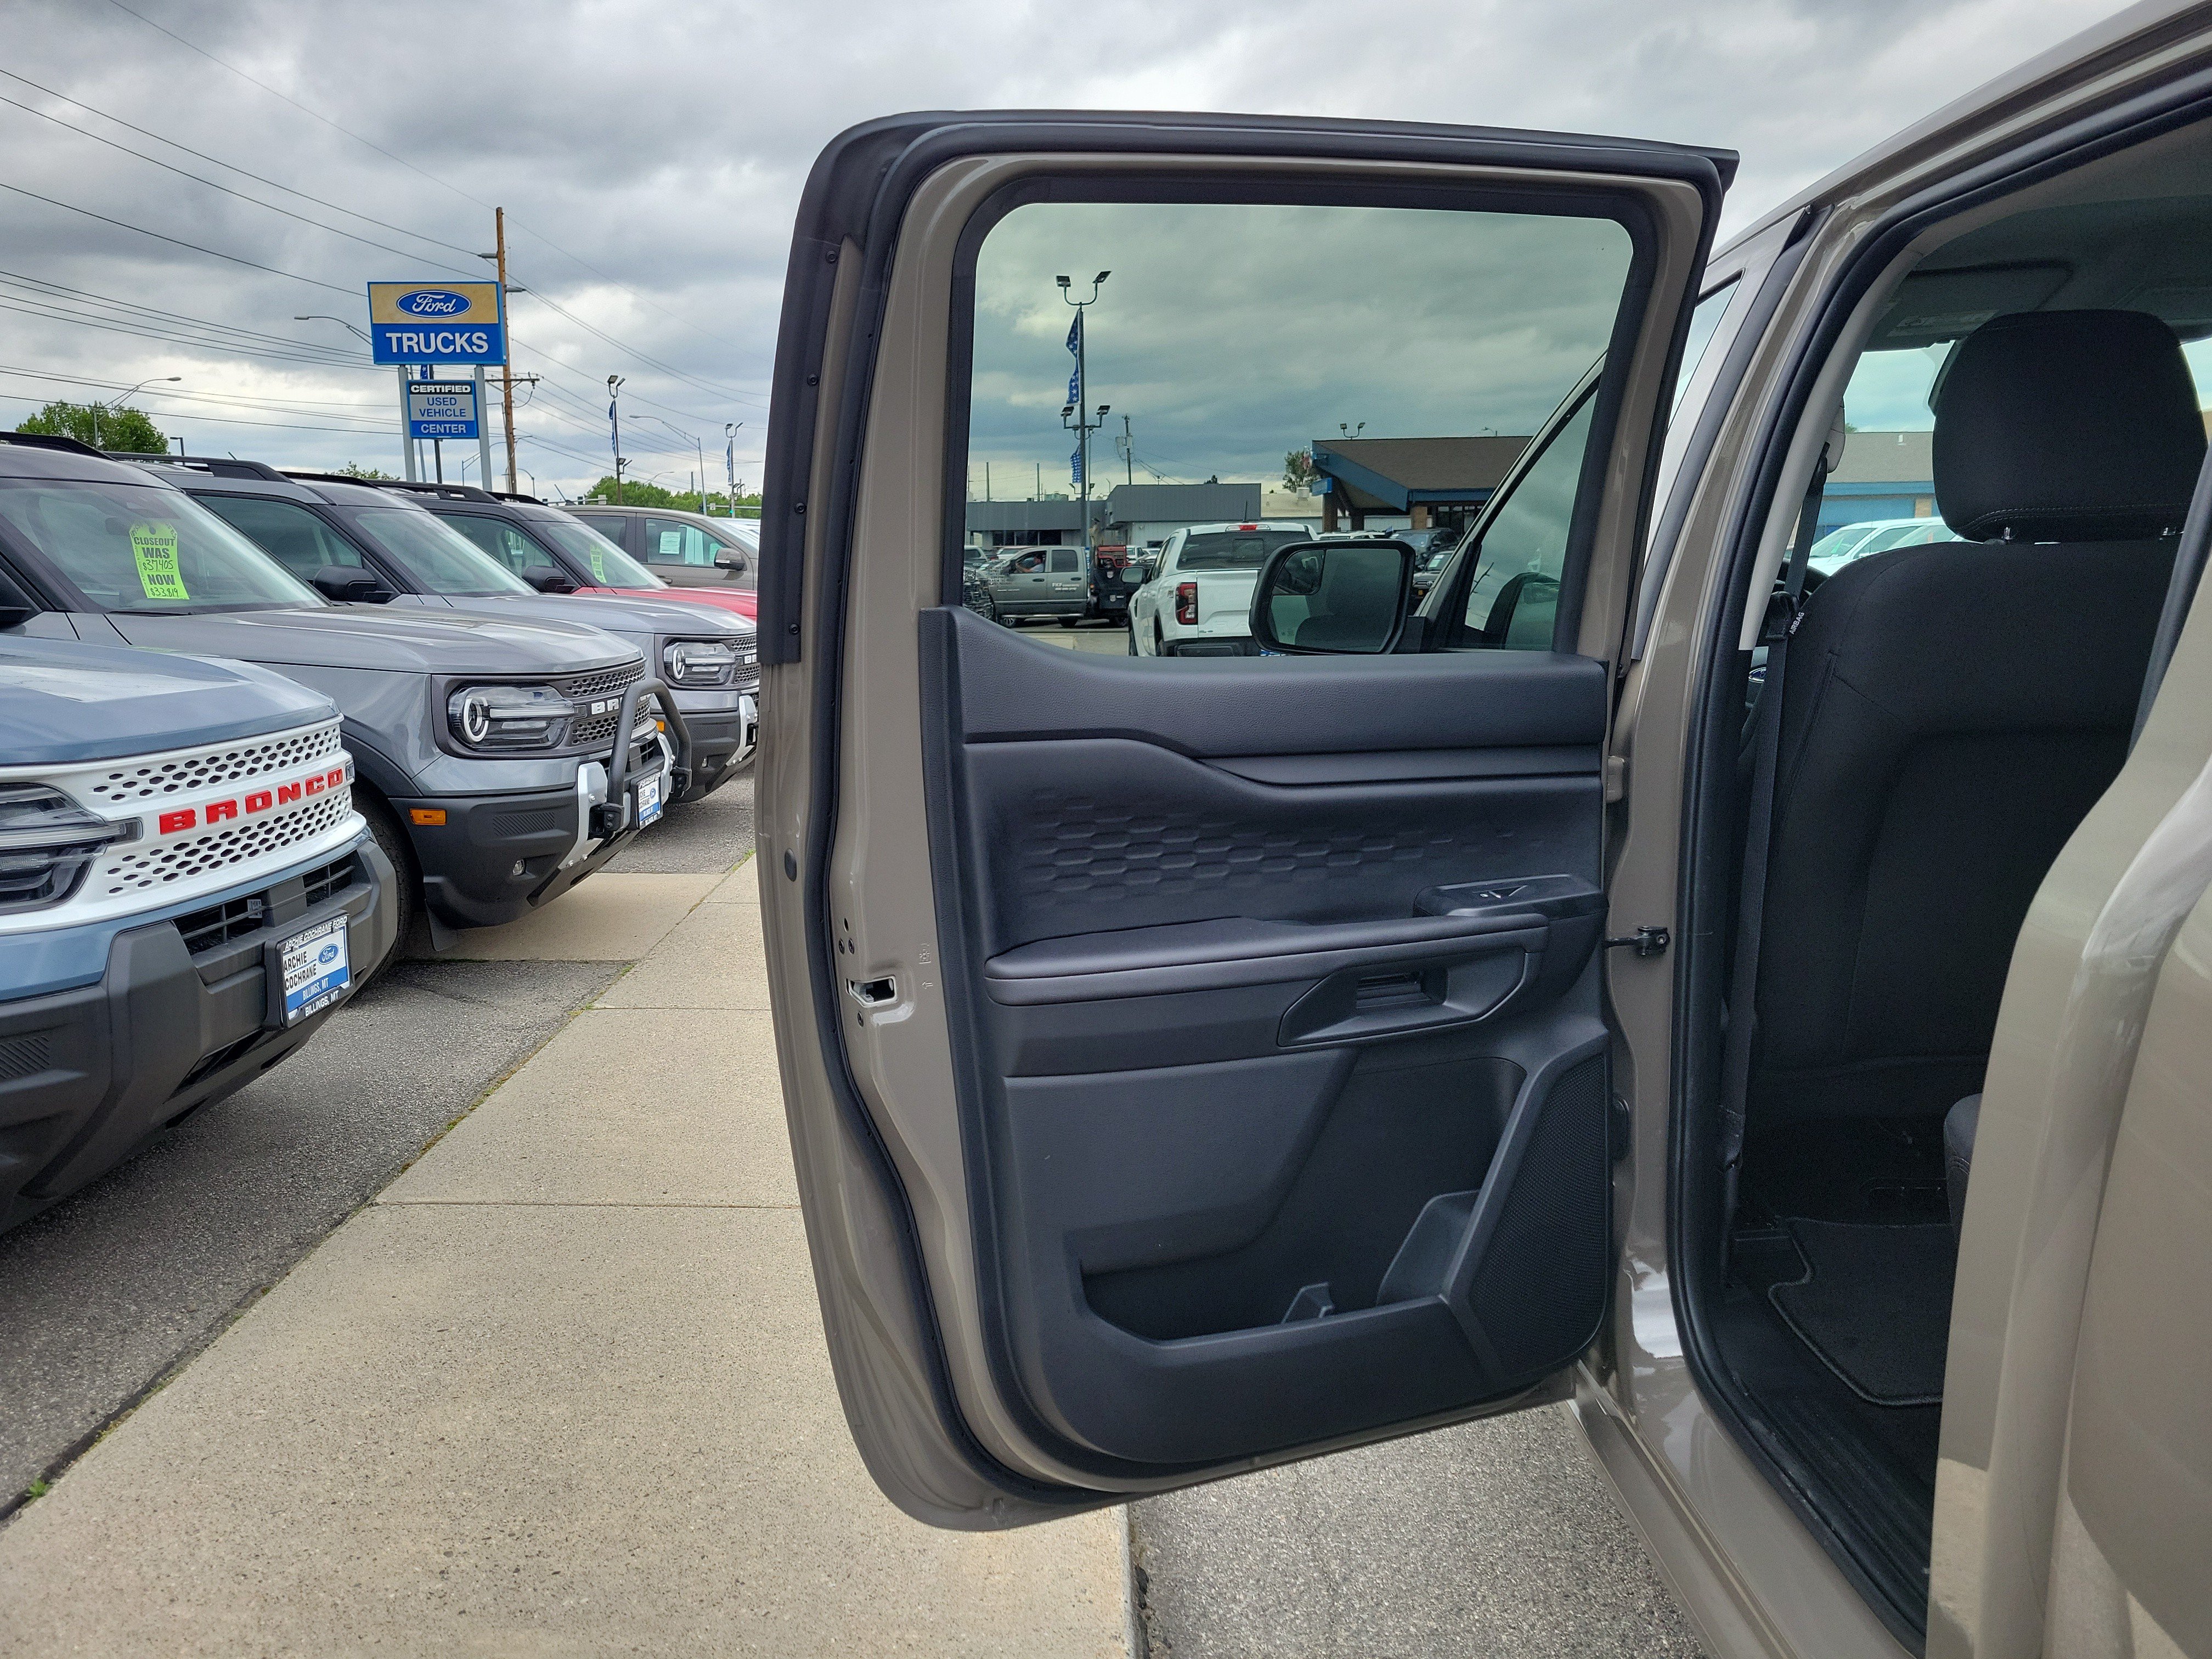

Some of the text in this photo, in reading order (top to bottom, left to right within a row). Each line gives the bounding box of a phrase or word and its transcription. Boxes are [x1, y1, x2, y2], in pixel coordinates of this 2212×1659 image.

[412, 294, 456, 312] Ford
[386, 332, 488, 353] TRUCKS
[411, 385, 471, 393] CERTIFIED
[427, 397, 457, 406] USED
[419, 408, 466, 417] VEHICLE
[421, 424, 466, 433] CENTER
[133, 537, 175, 546] CLOSEOUT
[142, 547, 170, 558] WAS
[147, 574, 176, 585] NOW
[1789, 612, 1804, 635] AIRBAG
[159, 768, 343, 835] BRONCO
[285, 916, 347, 950] ARCHIE COCHRANE FORD
[284, 951, 307, 973] ARCHIE
[322, 947, 335, 962] Ford
[285, 963, 317, 991] COCHRANE
[303, 978, 329, 1001] BILLINGS, MT
[305, 990, 338, 1017] BILLINGS, MT
